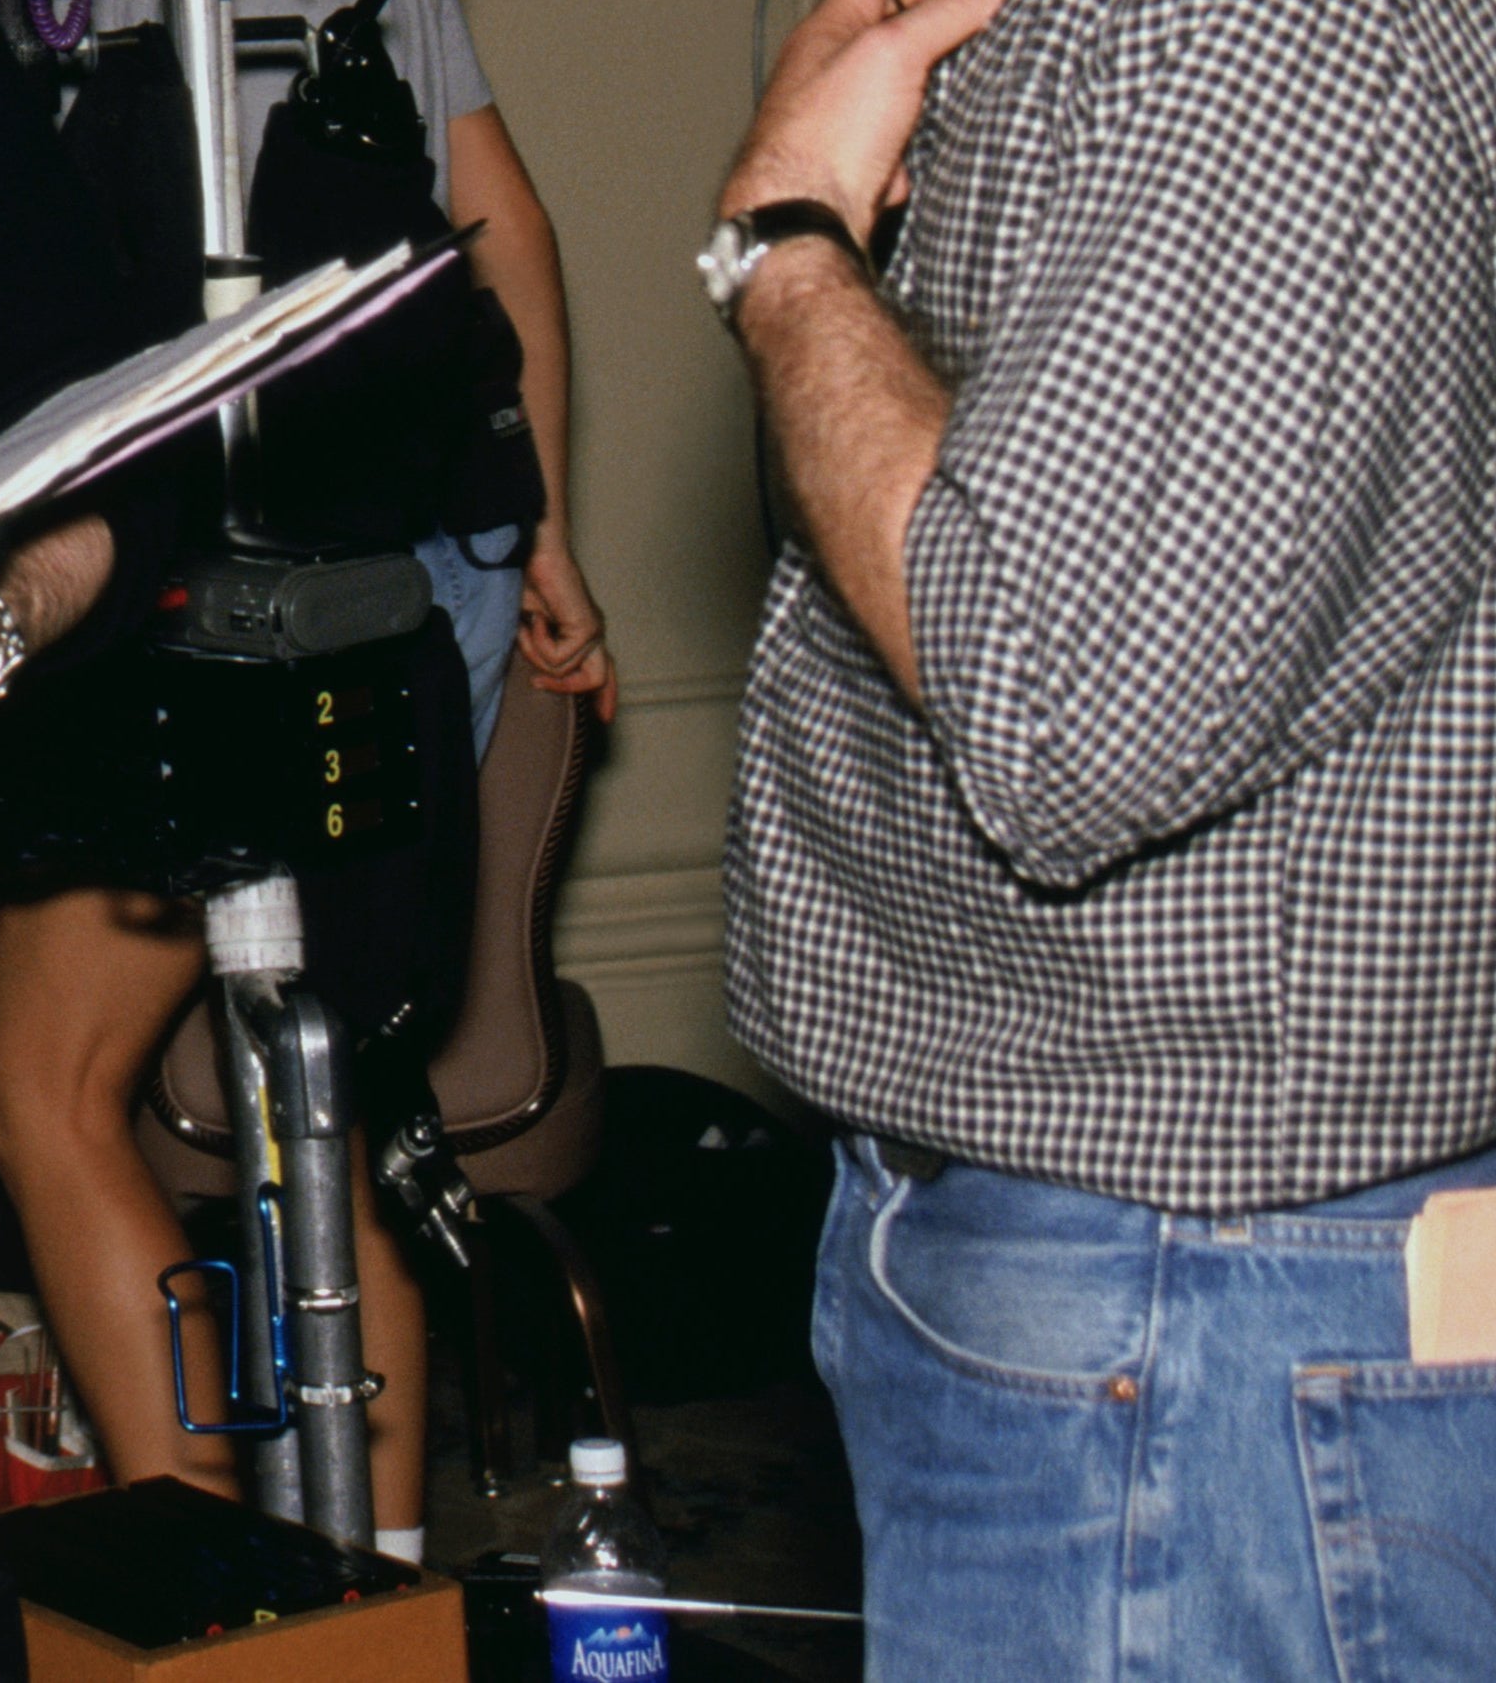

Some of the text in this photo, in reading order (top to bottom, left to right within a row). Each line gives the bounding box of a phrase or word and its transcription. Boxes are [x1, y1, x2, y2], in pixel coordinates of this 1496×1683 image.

[316, 691, 334, 725] 2
[324, 749, 341, 783] 3
[326, 803, 343, 837] 6
[571, 1634, 665, 1683] AQUAFINA
